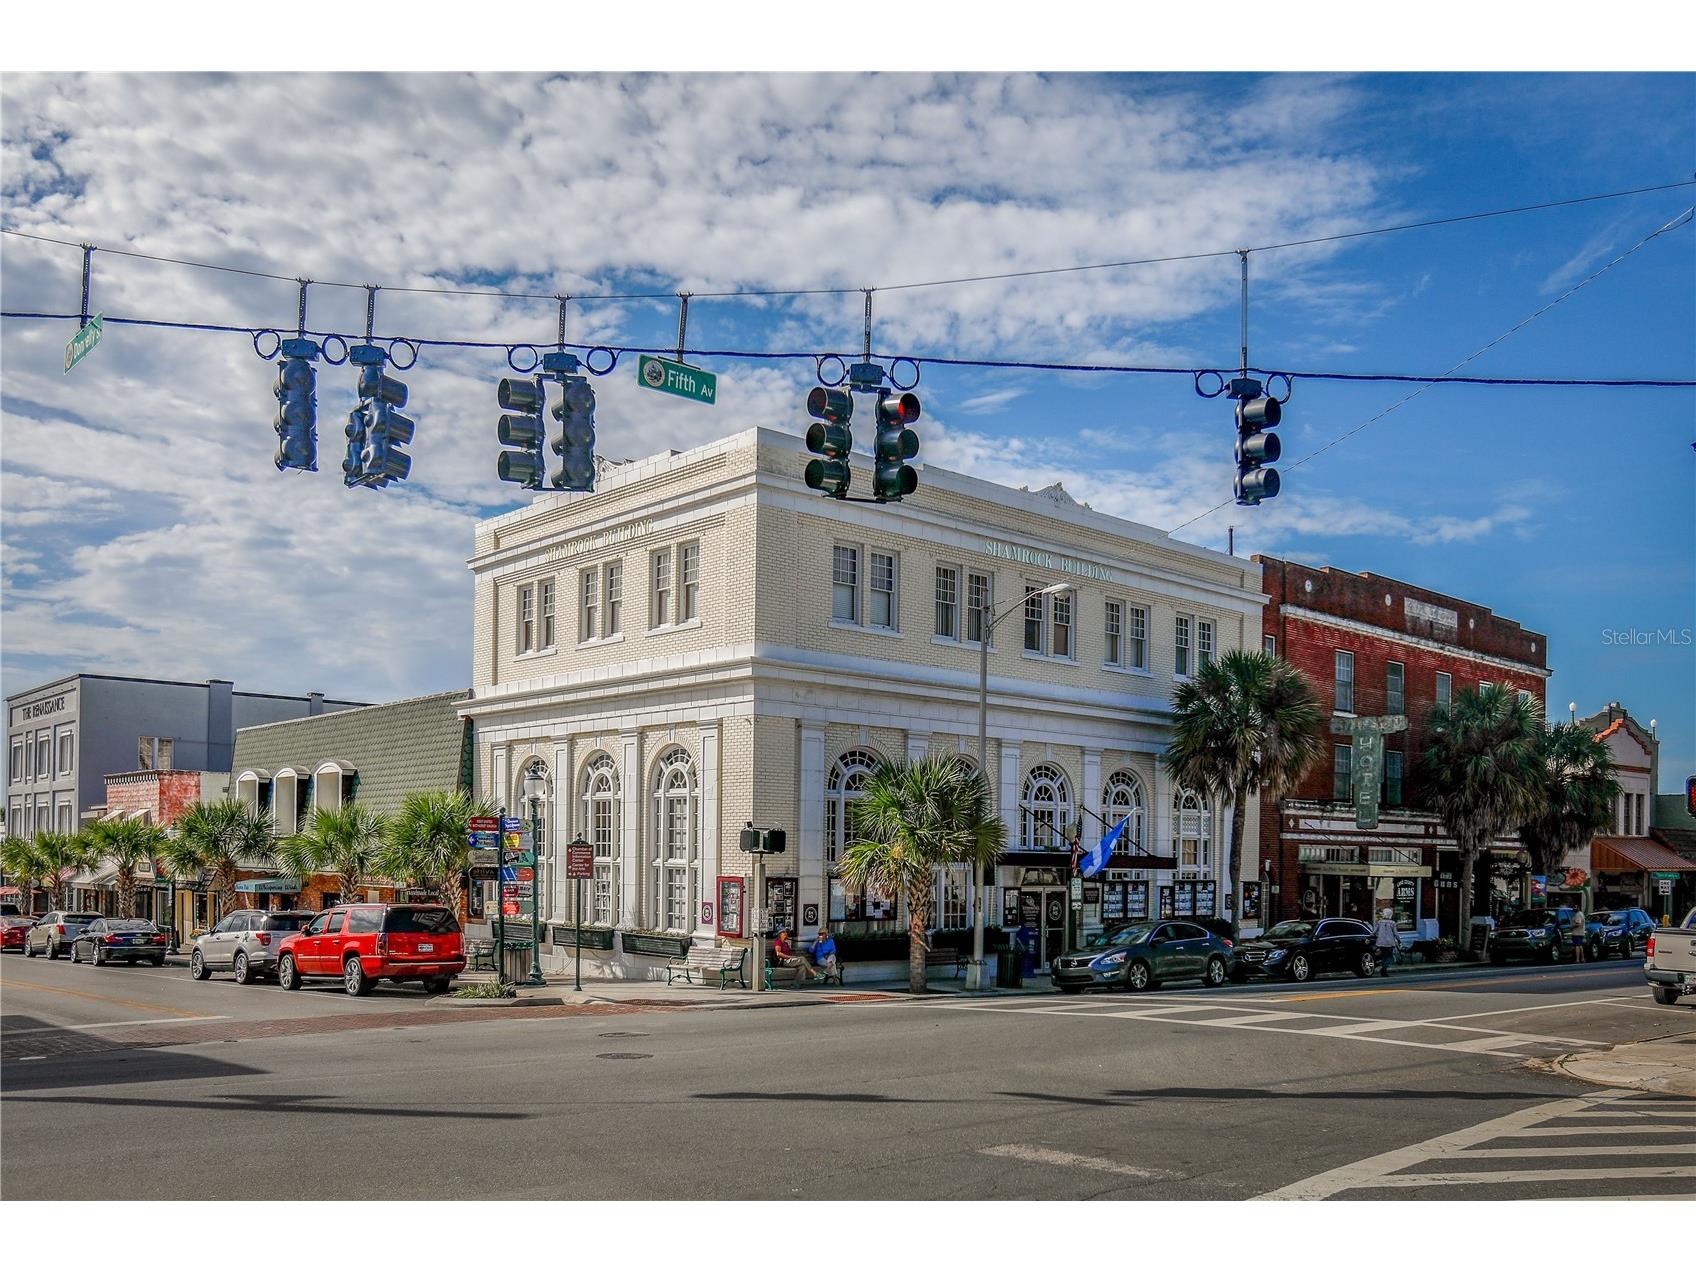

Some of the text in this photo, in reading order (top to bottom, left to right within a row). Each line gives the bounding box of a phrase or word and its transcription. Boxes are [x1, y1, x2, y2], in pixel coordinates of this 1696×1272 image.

[667, 369, 714, 398] Fifth Av
[543, 519, 654, 562] SHAMROCK BUILDING
[985, 541, 1113, 582] SHAMROCK BUILDING
[22, 696, 65, 720] THE RENAISSANCE
[1358, 735, 1374, 823] HOTEL
[1396, 887, 1415, 898] ARMS
